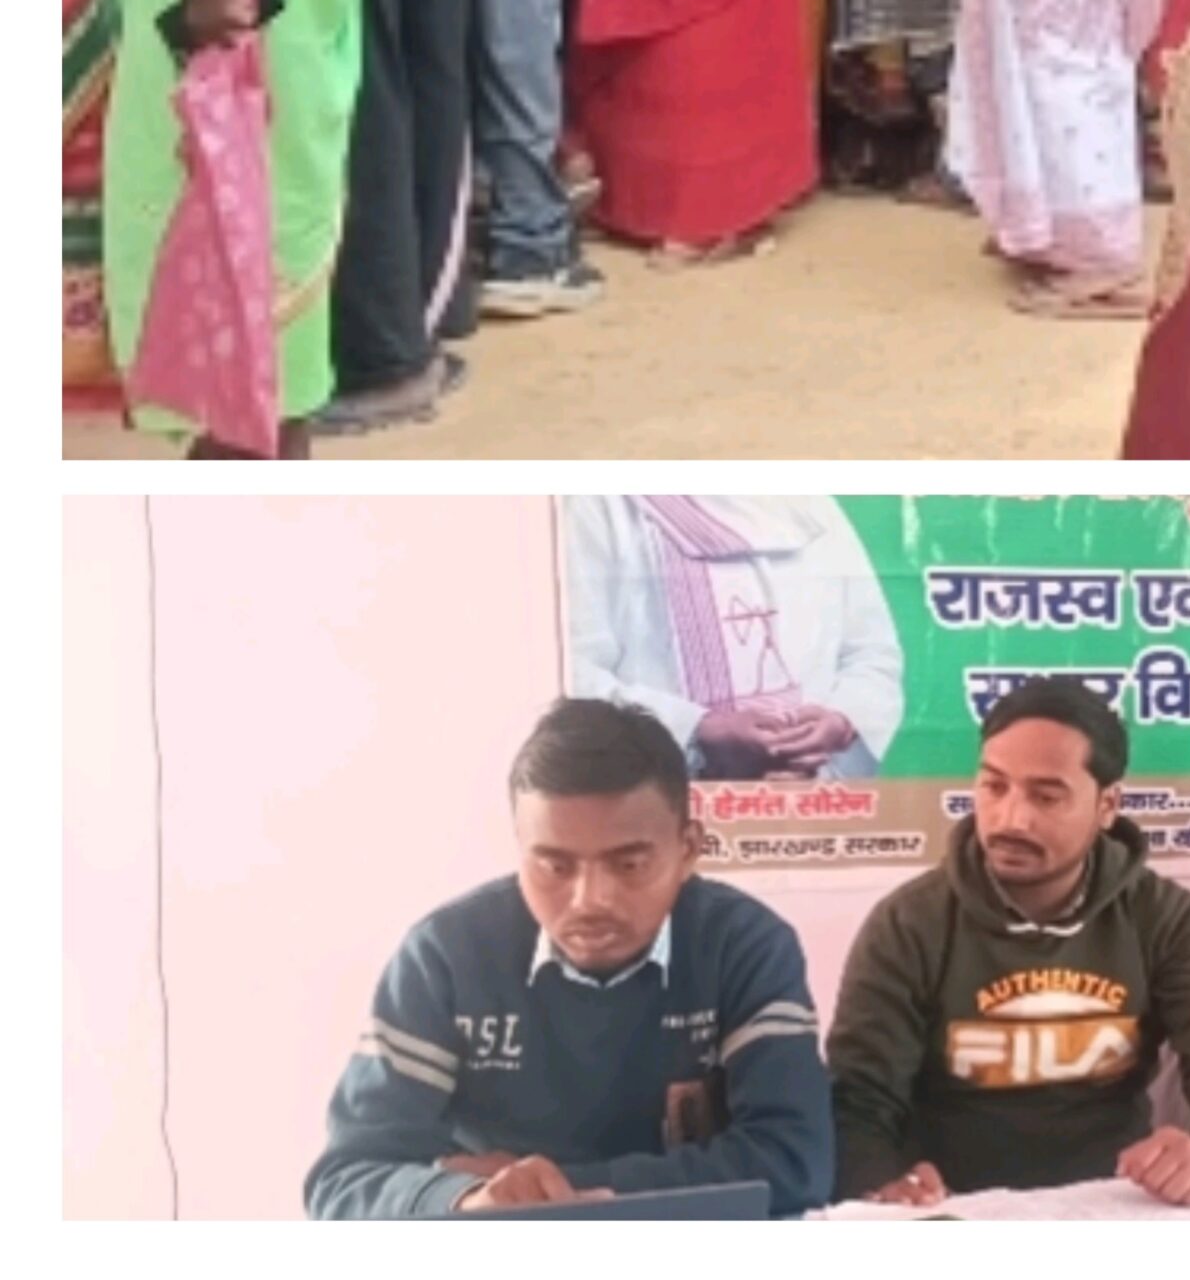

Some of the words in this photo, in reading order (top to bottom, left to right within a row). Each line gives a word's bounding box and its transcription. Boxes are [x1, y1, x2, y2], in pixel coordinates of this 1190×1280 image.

[929, 572, 1121, 628] राजस्व
[714, 787, 785, 820] हेमंत
[797, 786, 873, 817] सोरेन
[845, 835, 922, 855] सरकार
[976, 967, 1128, 1012] AUTHENTIC
[952, 1024, 1133, 1084] FILA
